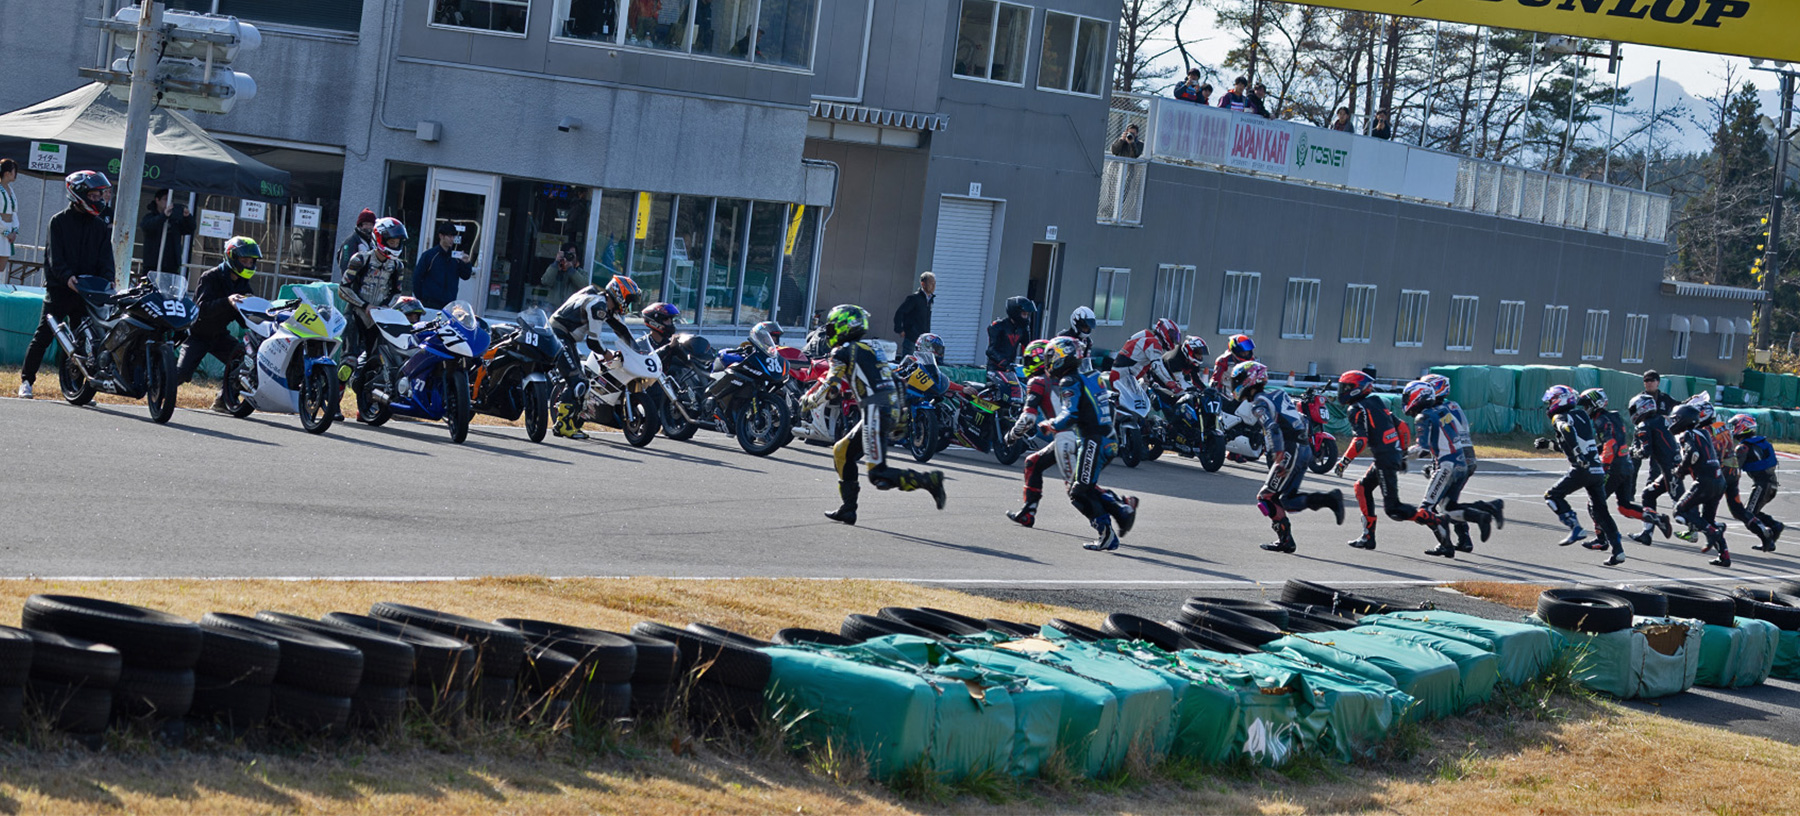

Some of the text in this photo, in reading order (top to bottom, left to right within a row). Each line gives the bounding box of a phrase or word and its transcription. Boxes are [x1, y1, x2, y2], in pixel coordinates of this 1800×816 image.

[1231, 123, 1290, 165] JAPAN KART
[37, 153, 59, 163] ライダー
[1310, 144, 1348, 168] TOSNET
[31, 161, 62, 172] 交代記入所
[143, 163, 160, 180] GO
[163, 300, 186, 318] 99
[438, 328, 465, 348] 27
[645, 358, 658, 373] 9
[766, 357, 783, 374] 38
[413, 378, 426, 392] 27
[914, 370, 930, 385] 96
[1207, 400, 1221, 413] 17
[1080, 440, 1097, 484] KUSHITANI
